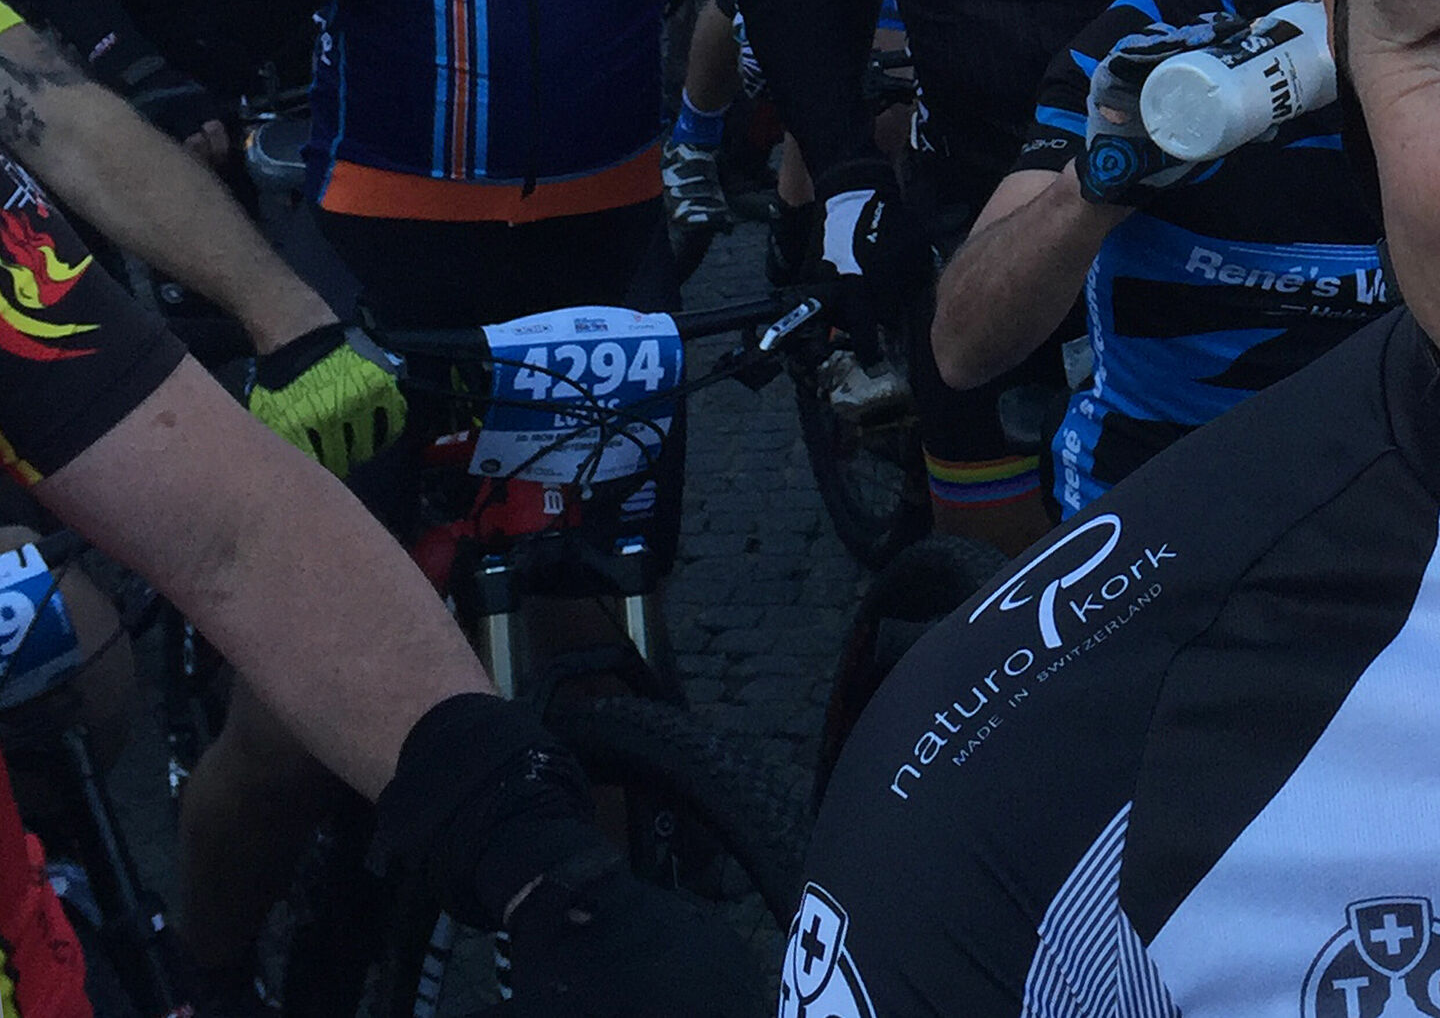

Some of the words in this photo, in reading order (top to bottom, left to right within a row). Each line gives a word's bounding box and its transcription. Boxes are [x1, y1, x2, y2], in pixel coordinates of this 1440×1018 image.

[1184, 245, 1342, 298] René's
[513, 338, 666, 401] 4294
[890, 646, 1035, 801] naturo
[1069, 542, 1178, 624] kork
[951, 715, 1005, 768] MADE
[1008, 688, 1030, 710] IN
[1036, 583, 1165, 684] SWITZERLAND
